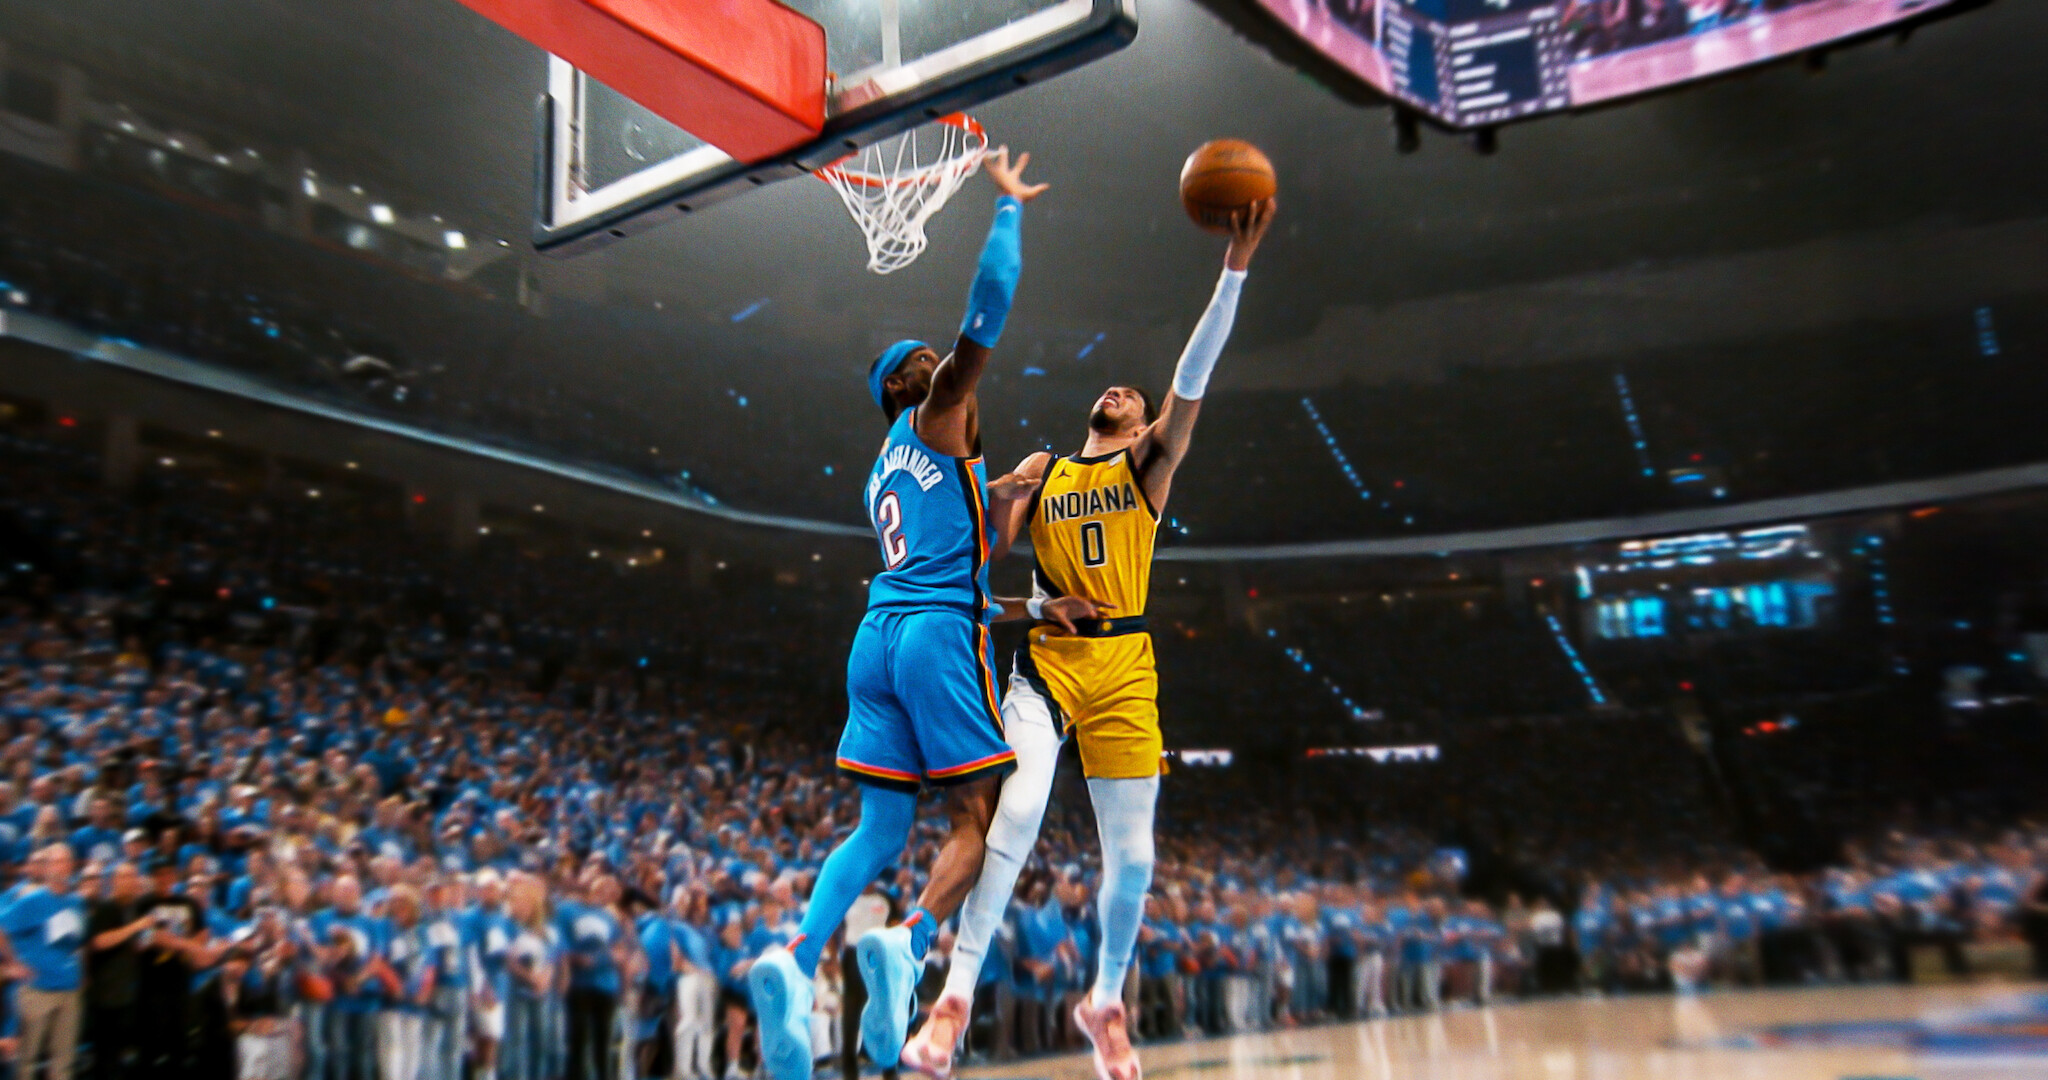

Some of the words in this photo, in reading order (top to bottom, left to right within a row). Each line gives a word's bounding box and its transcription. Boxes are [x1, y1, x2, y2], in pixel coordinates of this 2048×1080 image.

[1043, 481, 1139, 525] INDIANA
[878, 489, 908, 571] 2
[1080, 520, 1108, 568] 0
